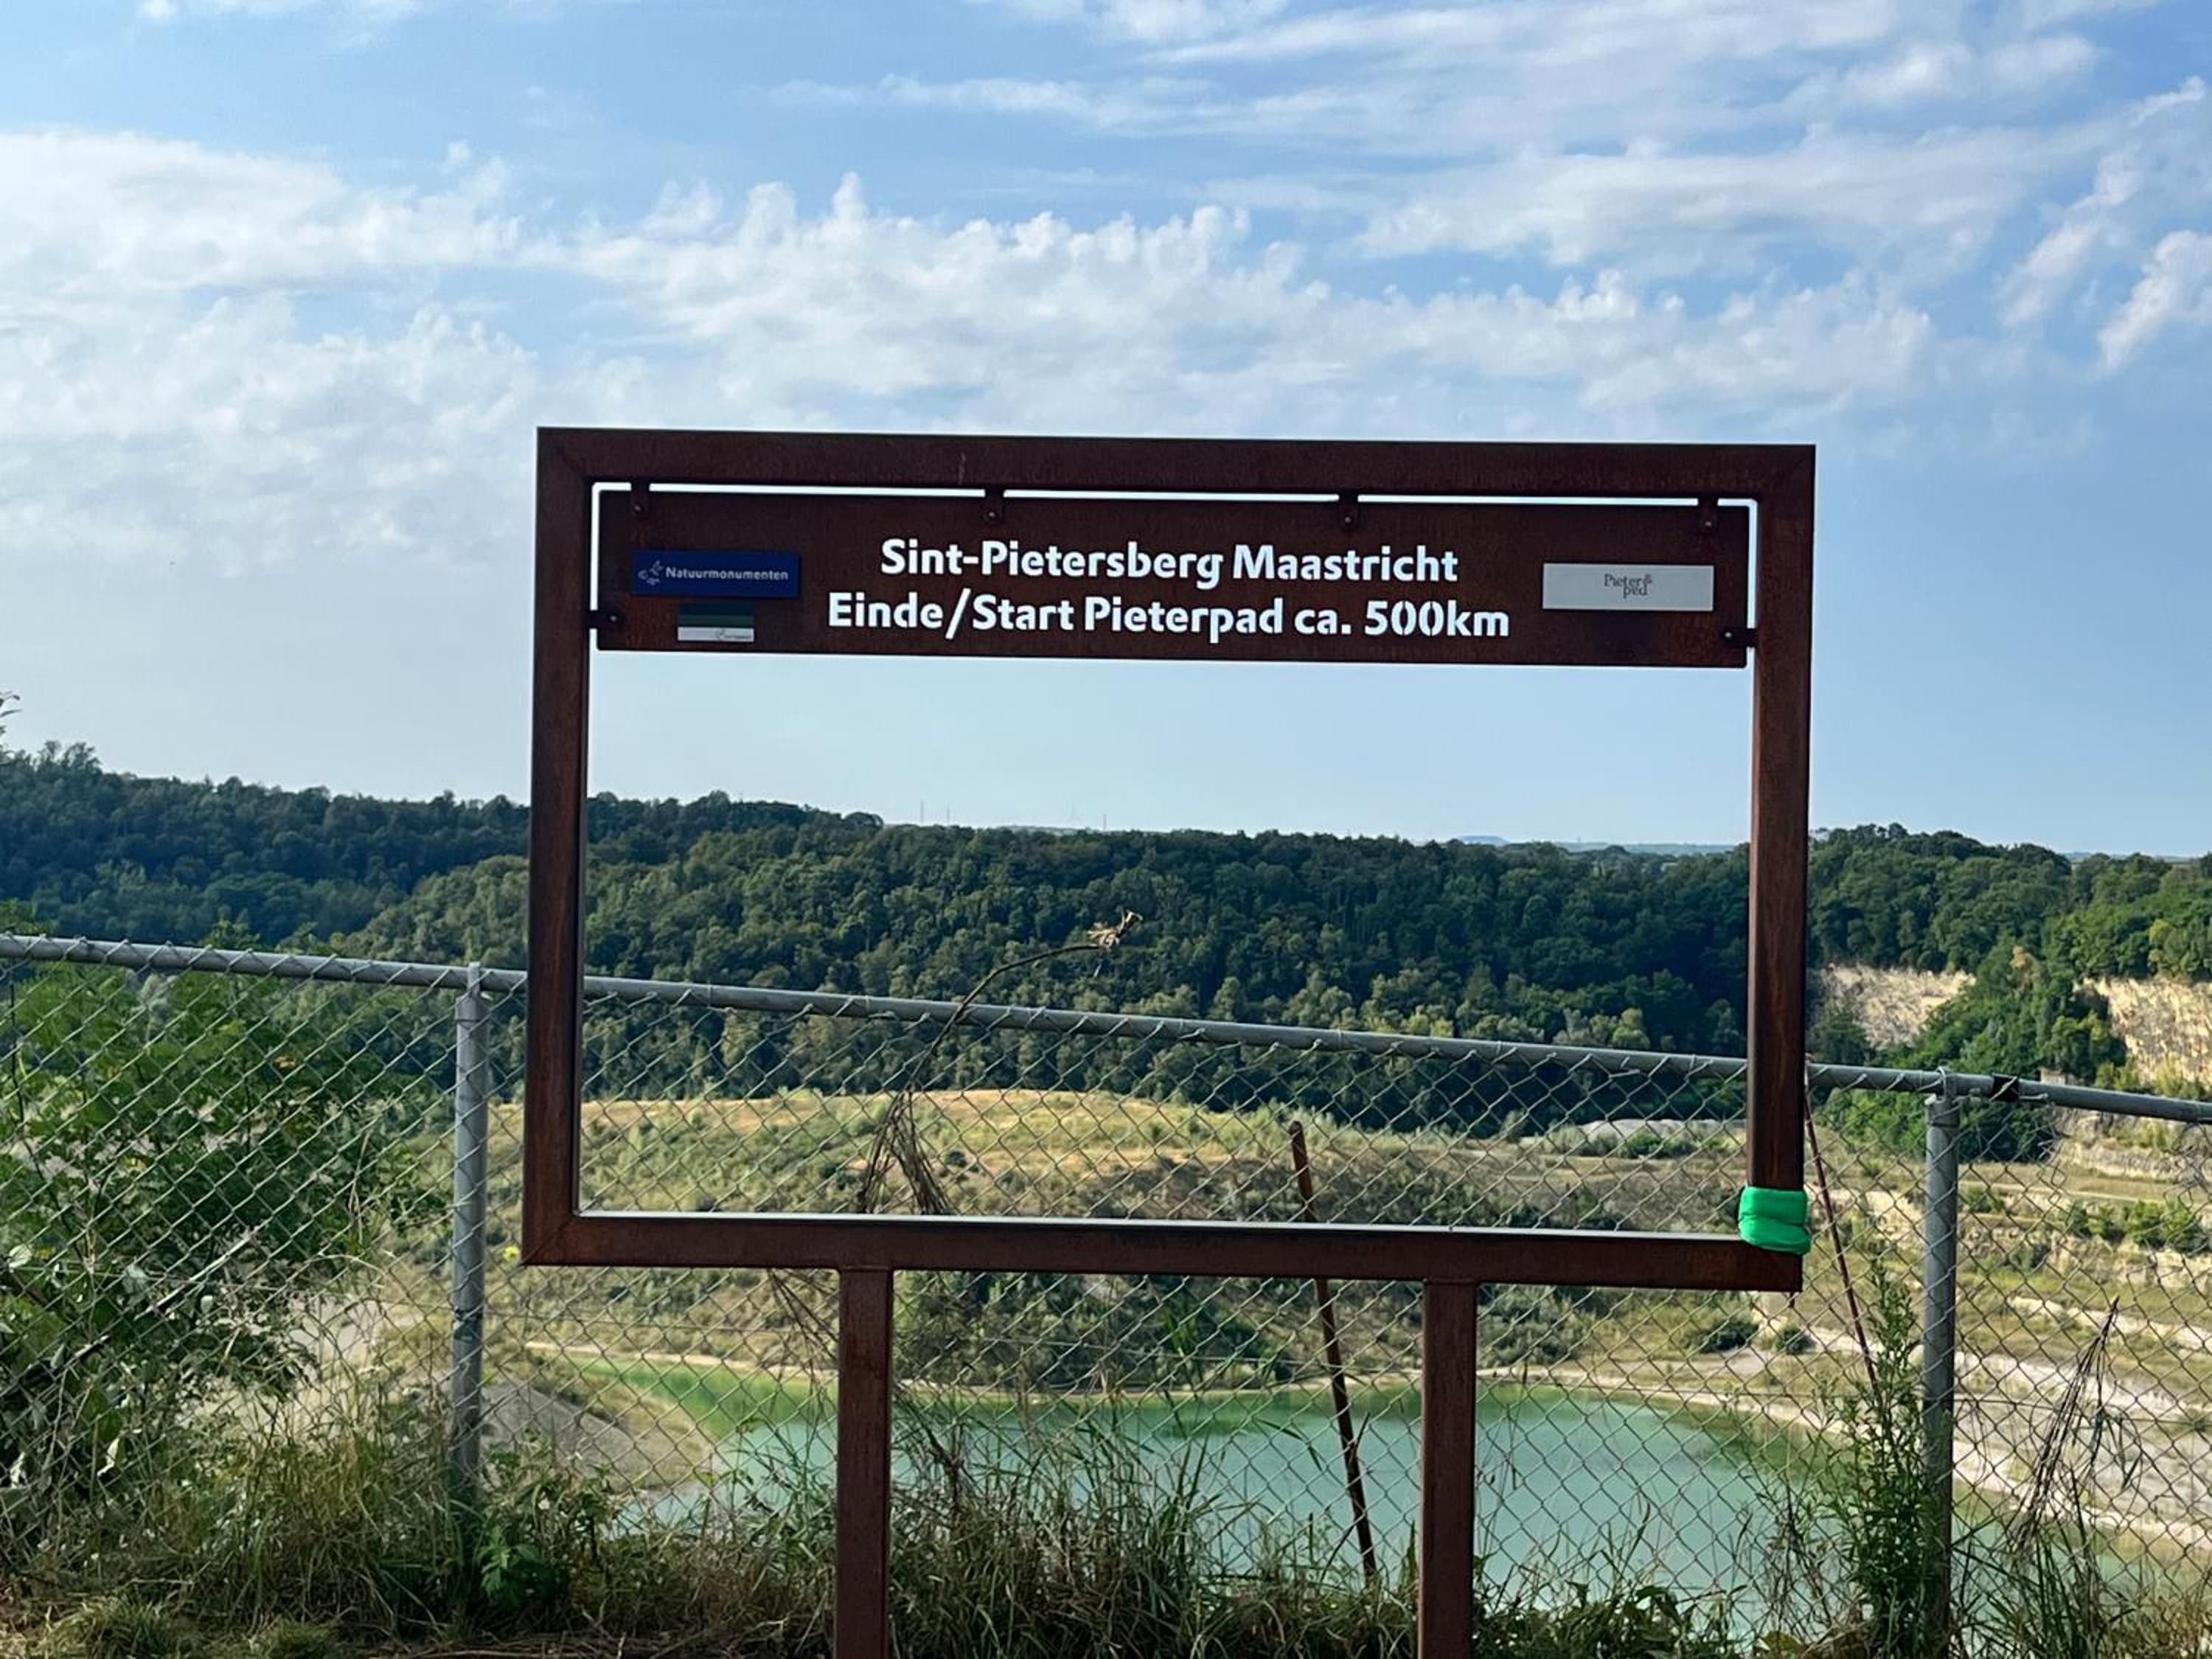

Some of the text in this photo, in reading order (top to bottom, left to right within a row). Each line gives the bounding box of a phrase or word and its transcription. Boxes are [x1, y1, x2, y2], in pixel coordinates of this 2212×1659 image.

[665, 567, 789, 580] Natuurmonumenten
[881, 538, 1458, 591] Sint-Pietersberg Maastricht
[829, 588, 1509, 644] Einde/Start Pieterpad ca. 500km
